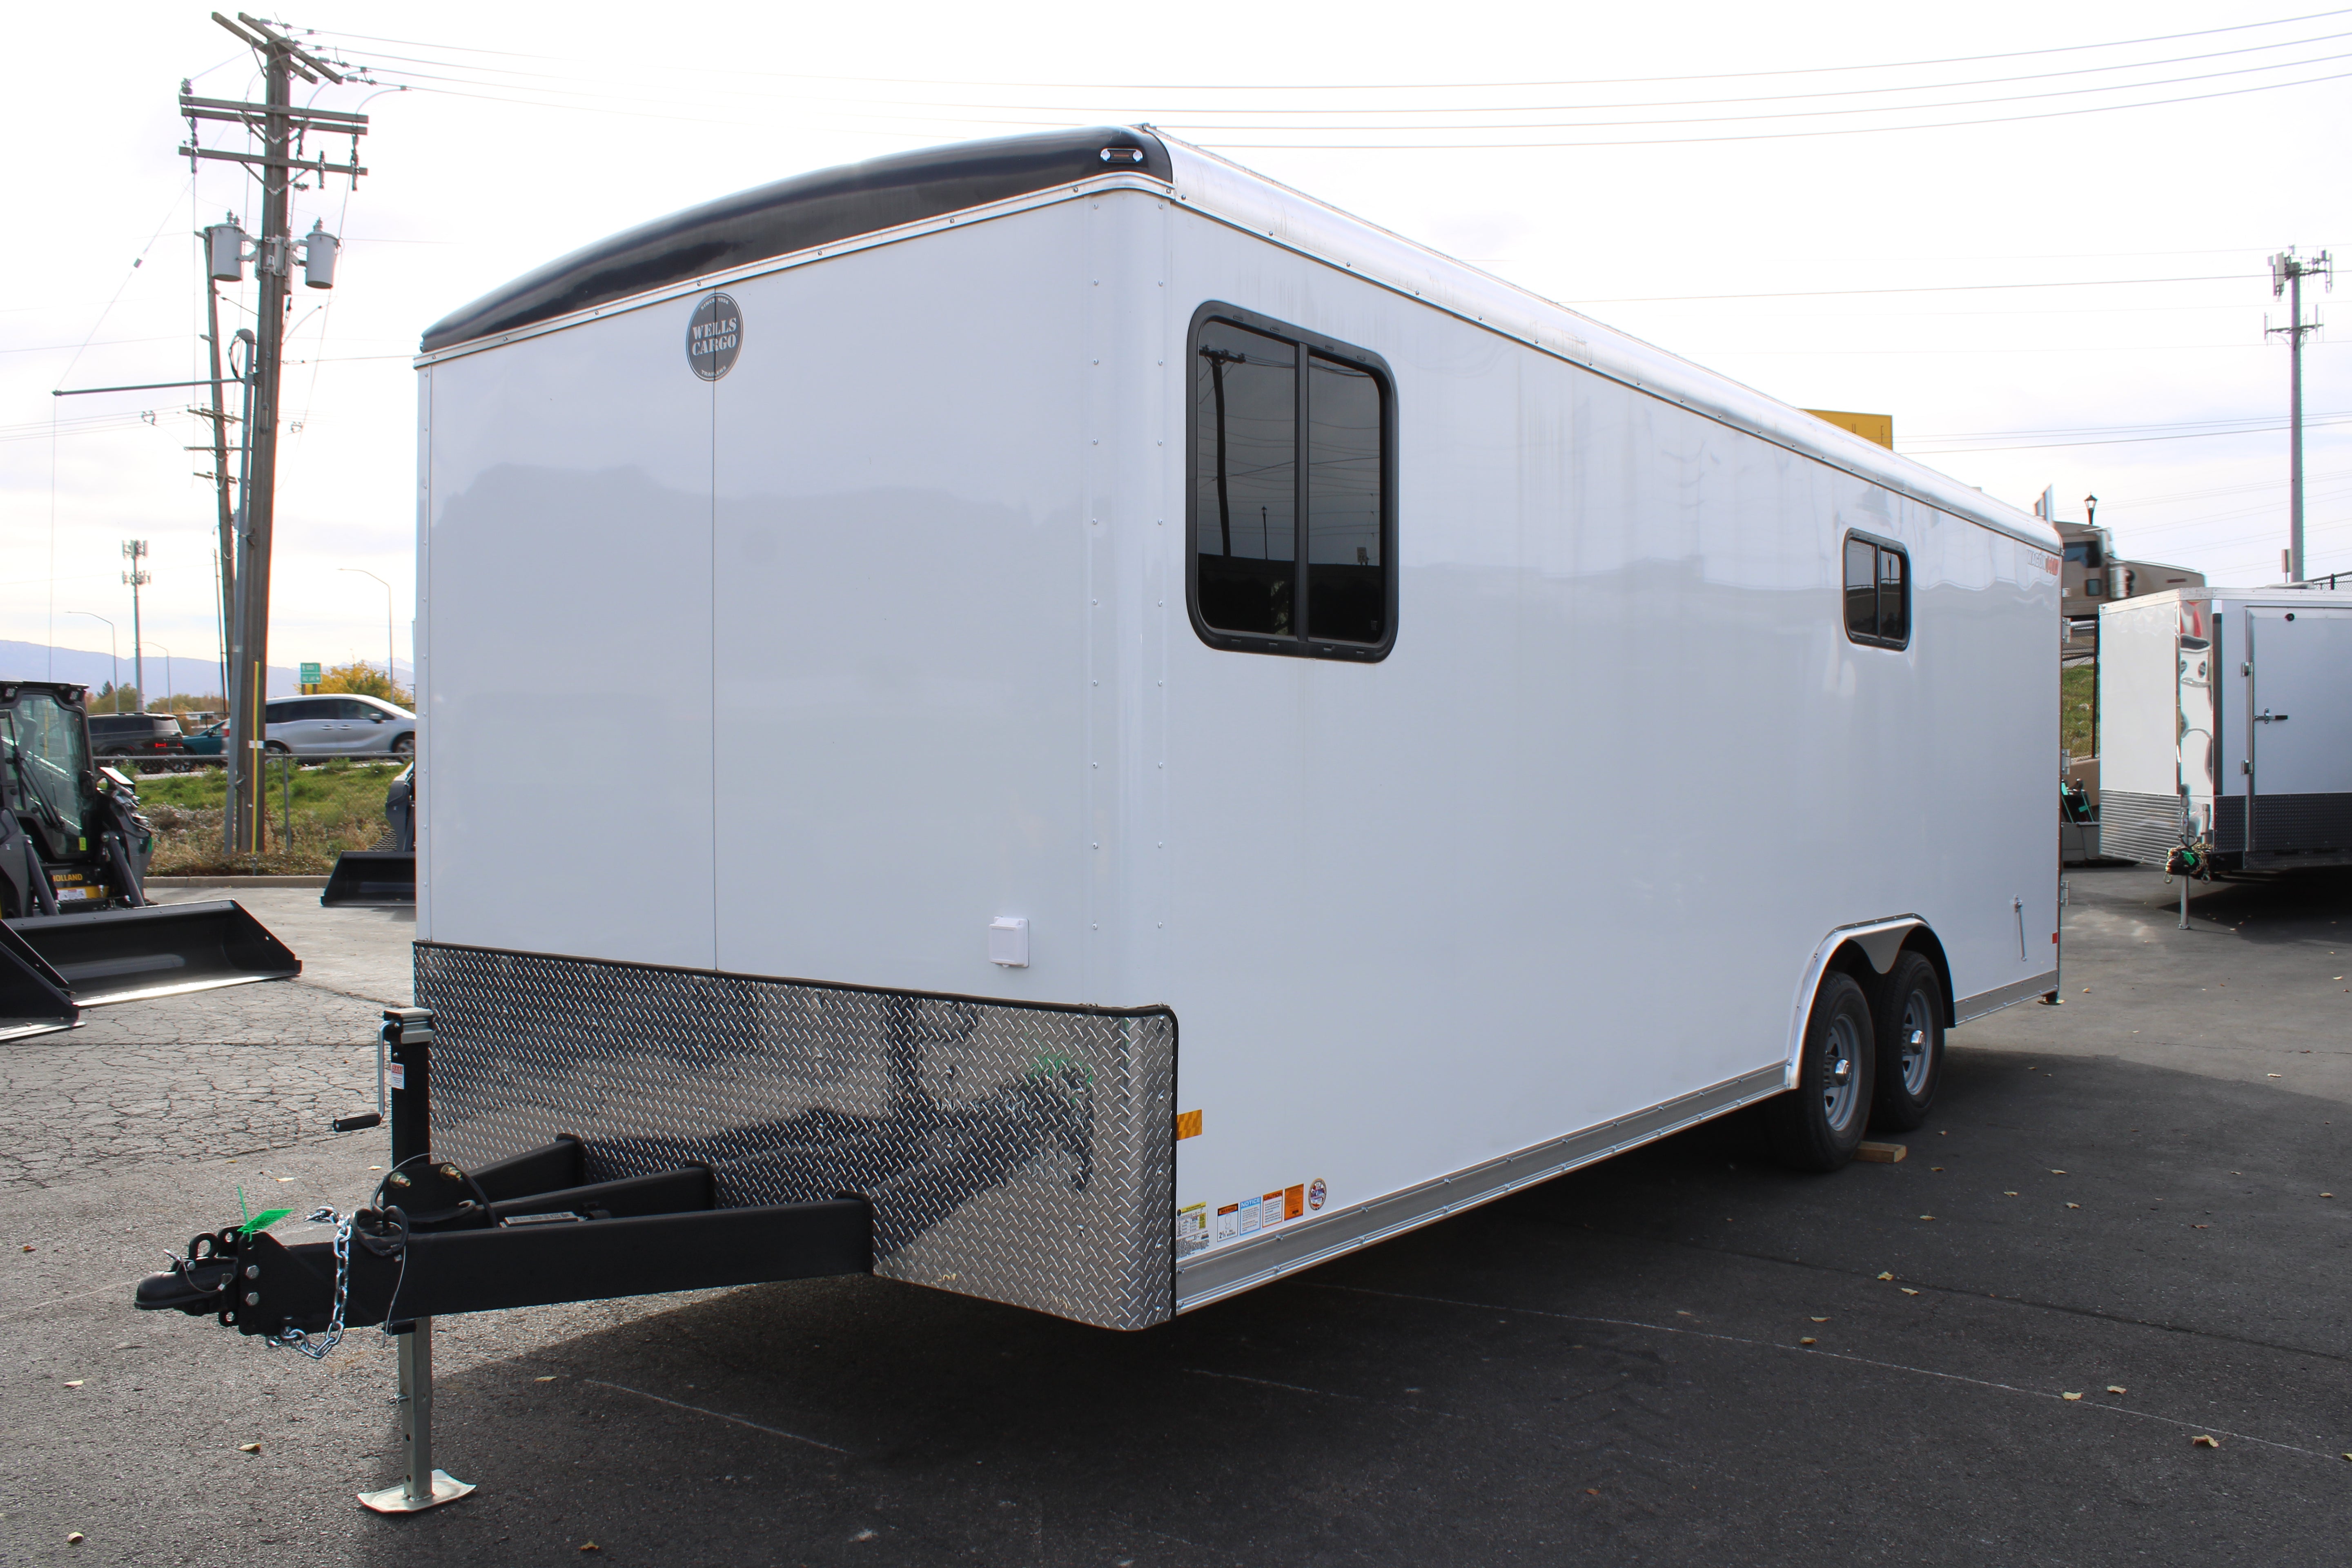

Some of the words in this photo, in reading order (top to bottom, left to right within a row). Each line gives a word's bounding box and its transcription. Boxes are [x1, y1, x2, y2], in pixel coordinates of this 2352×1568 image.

[700, 298, 716, 310] SINCE
[692, 317, 737, 340] WELLS
[692, 334, 737, 356] CARGO
[1263, 1191, 1283, 1201] CAUTION
[1241, 1197, 1261, 1208] NOTICE
